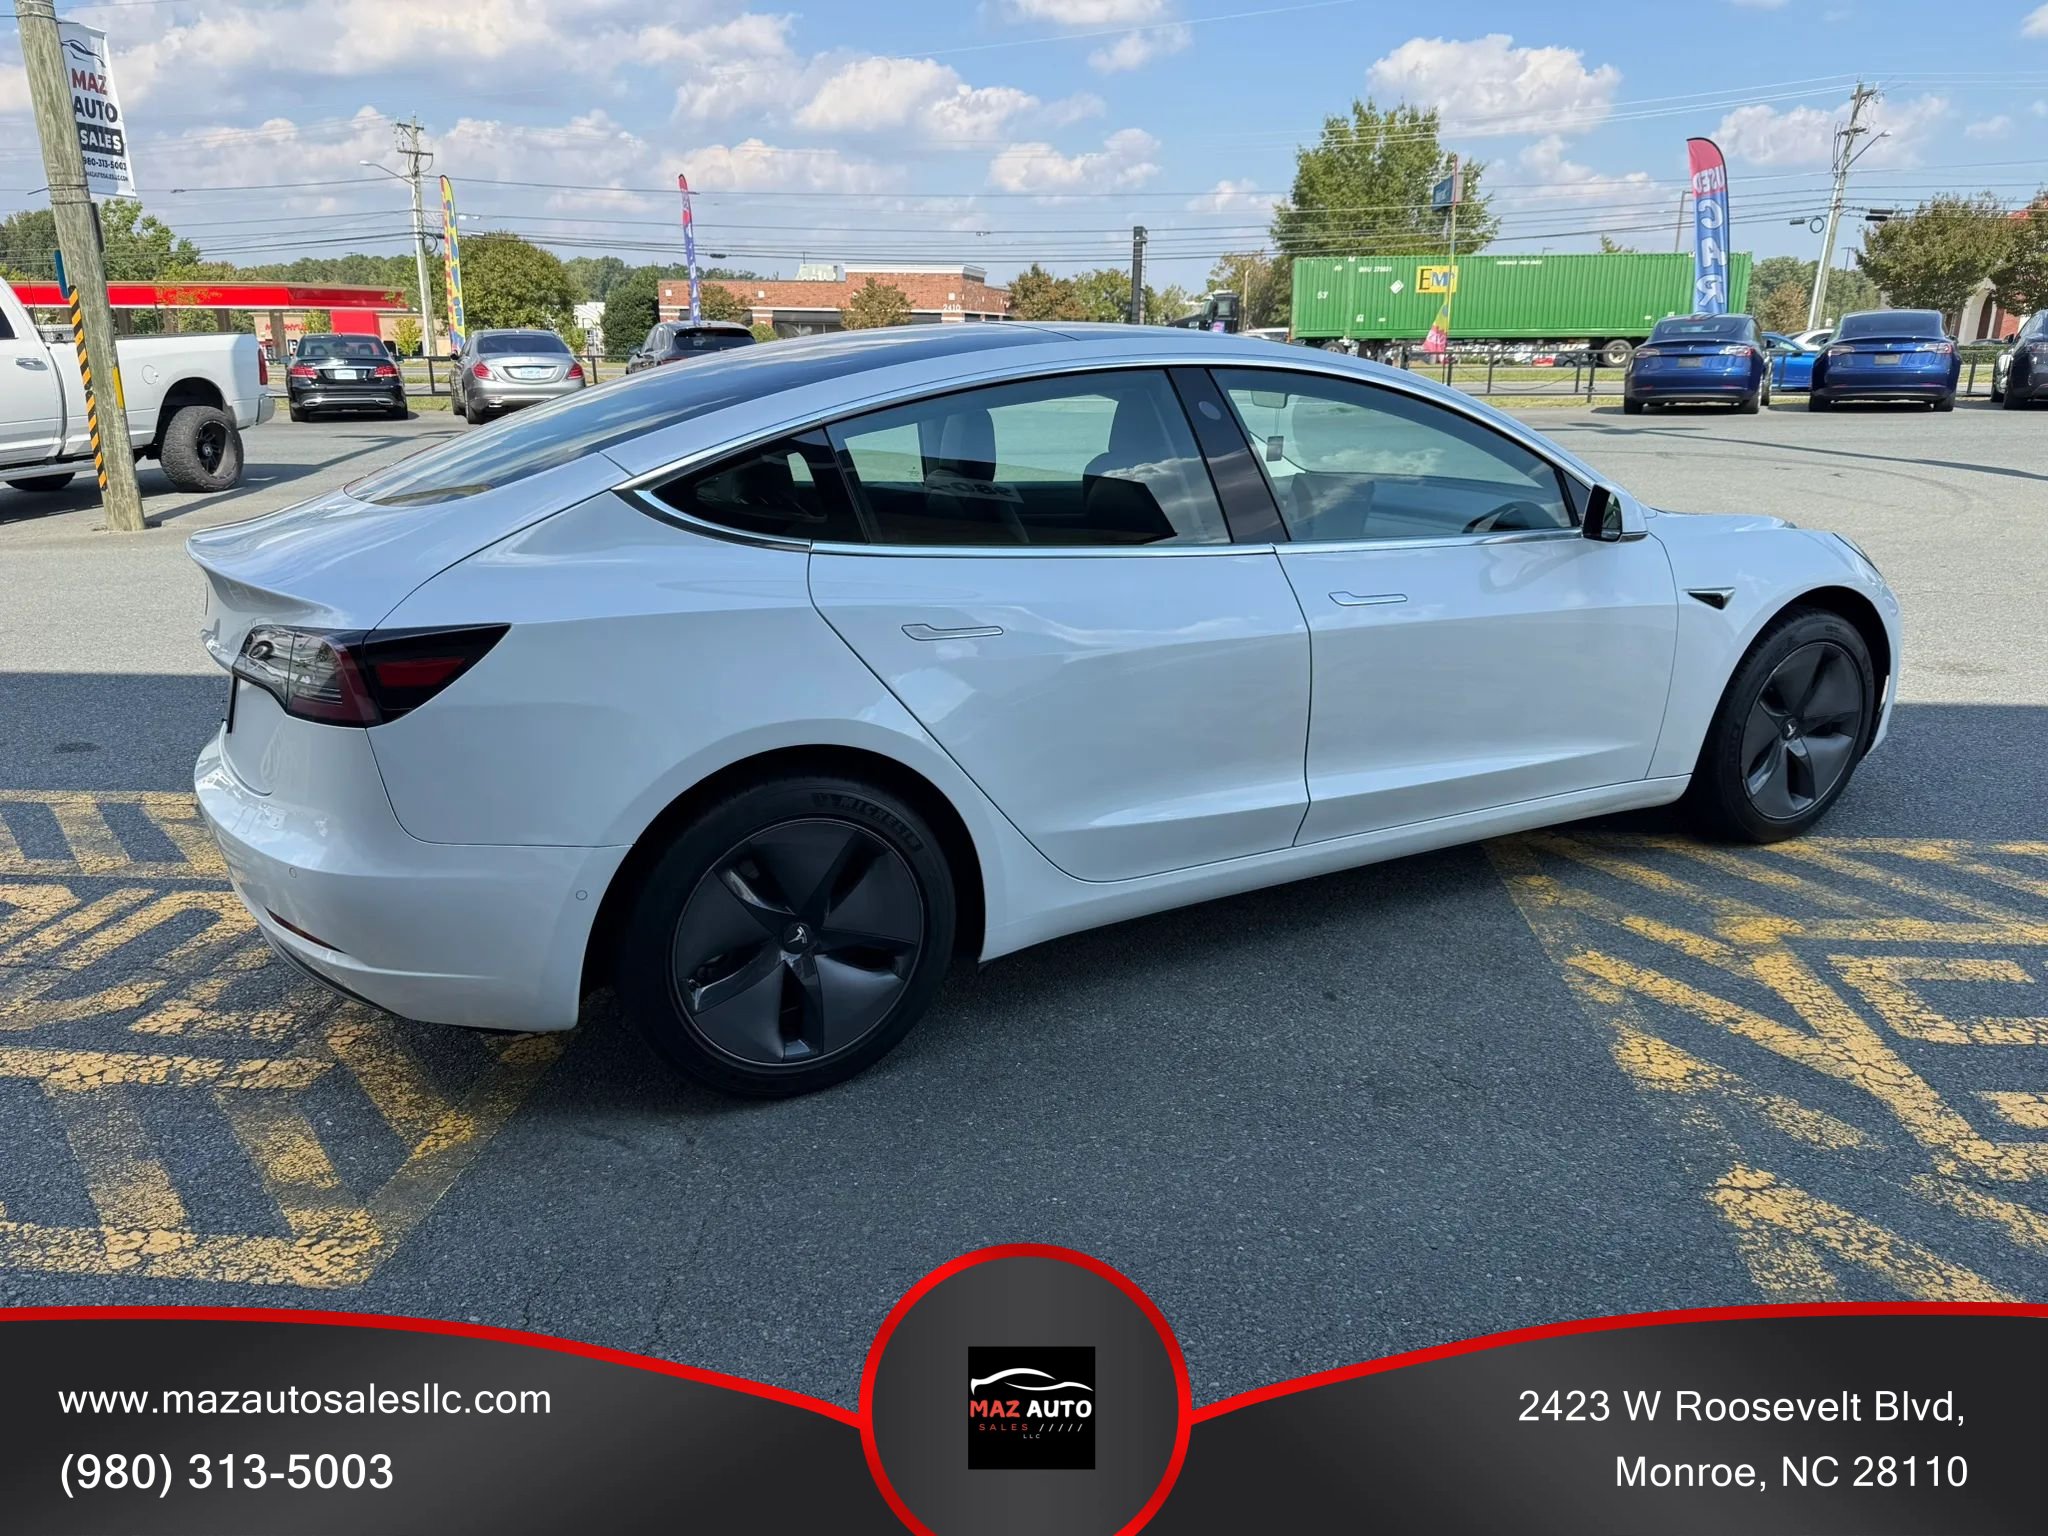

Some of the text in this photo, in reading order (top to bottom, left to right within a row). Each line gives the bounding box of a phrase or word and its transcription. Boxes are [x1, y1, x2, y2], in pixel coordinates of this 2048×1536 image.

[71, 67, 107, 96] MAZ
[74, 95, 118, 123] AUTO
[80, 129, 122, 151] SALES
[943, 303, 960, 312] 2410
